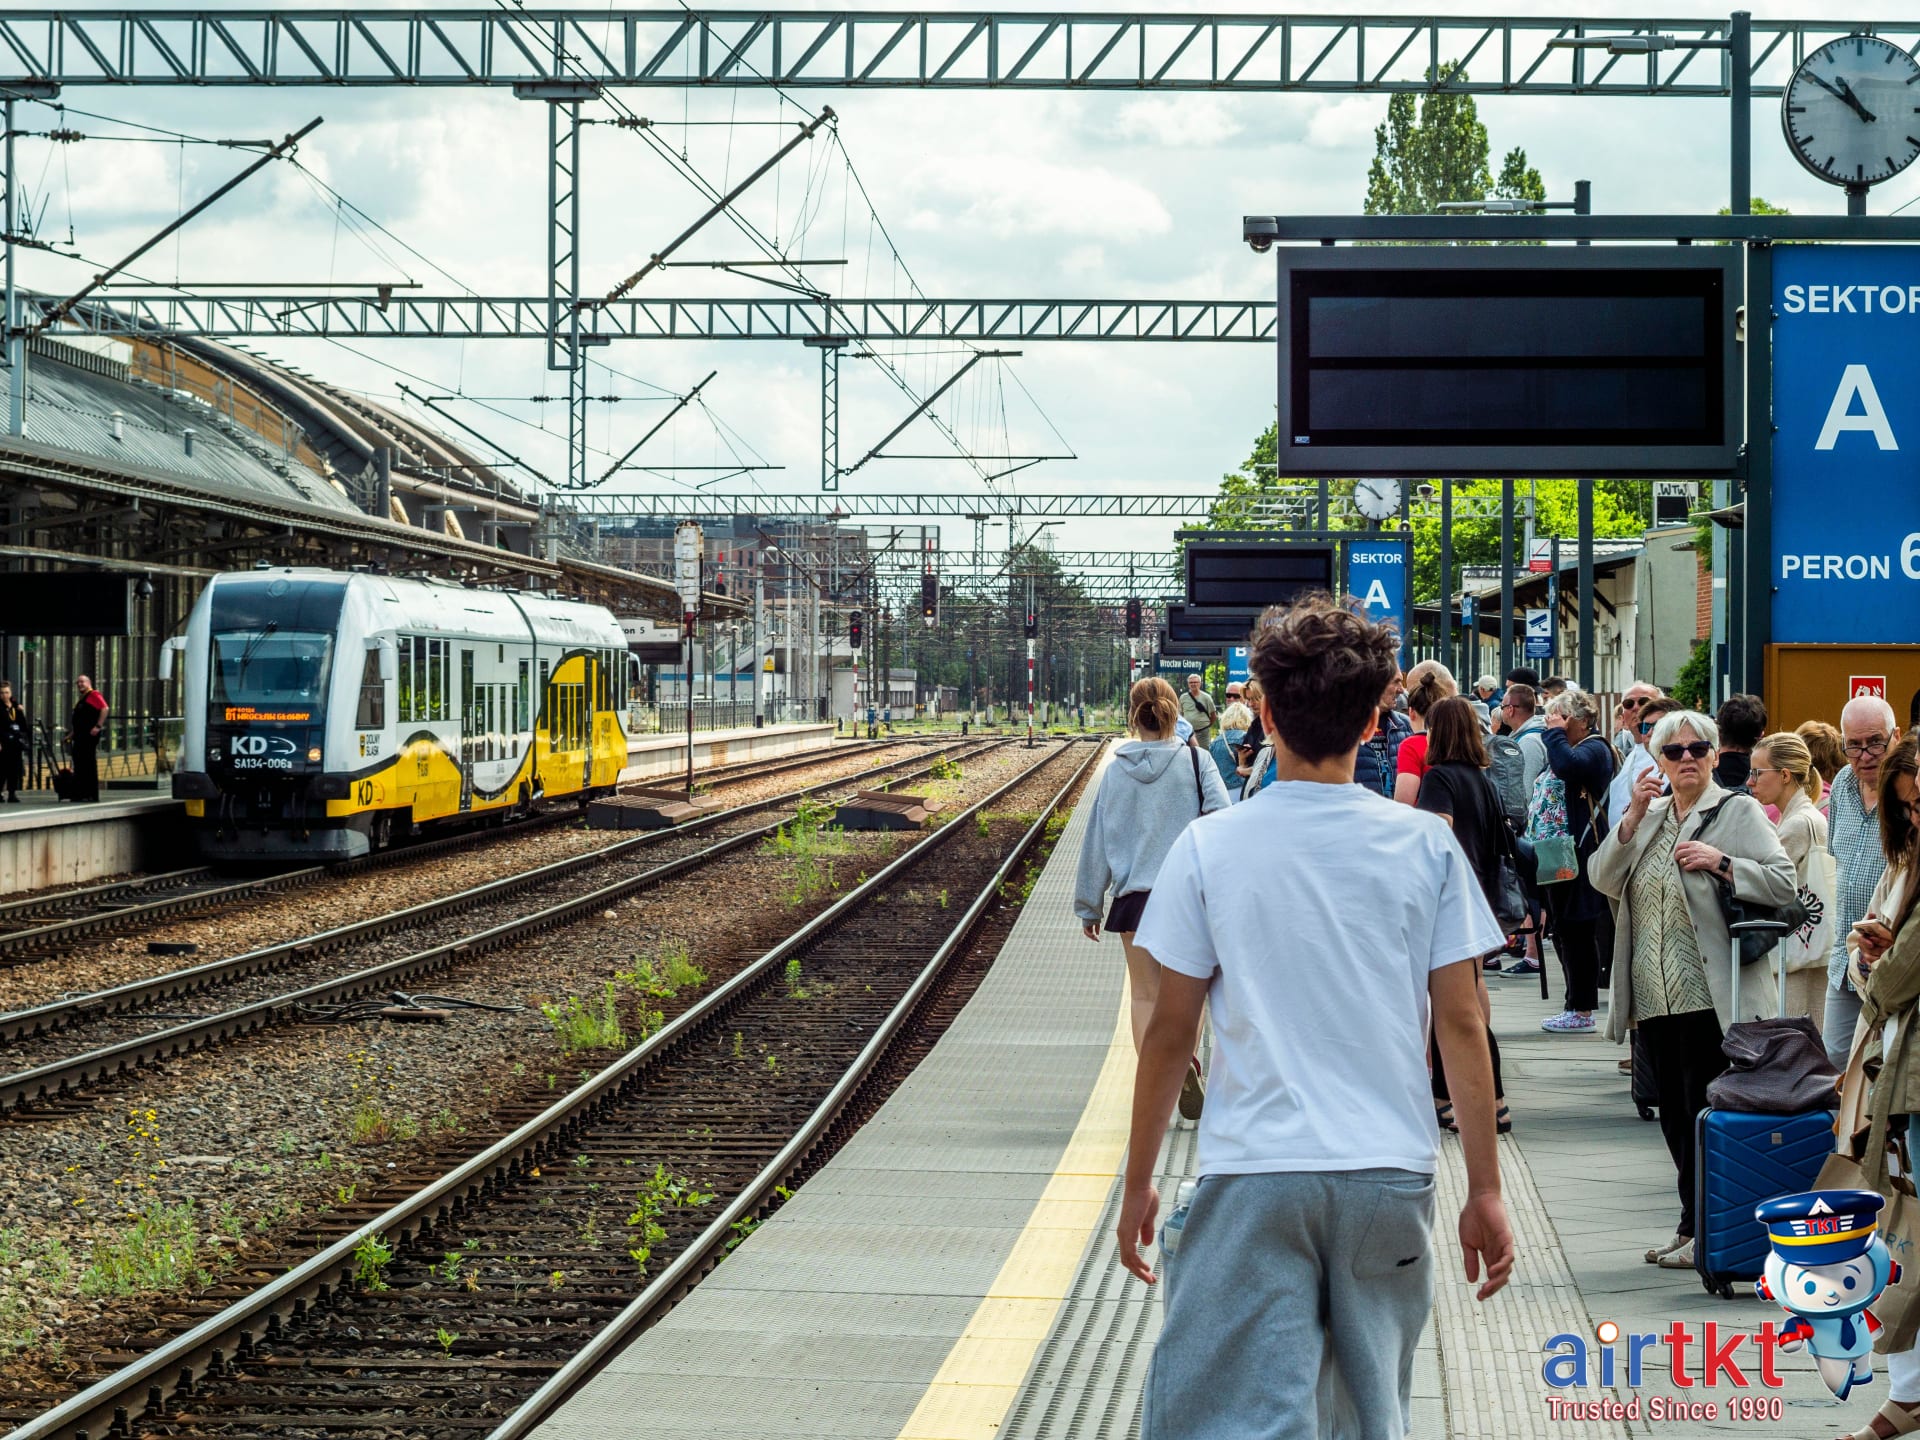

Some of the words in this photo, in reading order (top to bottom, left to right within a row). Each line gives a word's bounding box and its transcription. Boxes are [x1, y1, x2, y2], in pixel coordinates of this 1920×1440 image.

[1814, 364, 1899, 450] A
[1352, 553, 1403, 564] SEKTOR
[1782, 555, 1890, 579] PERON
[1363, 579, 1391, 609] A
[231, 736, 267, 755] KD
[234, 758, 293, 769] SA134-006a
[358, 781, 373, 807] KD
